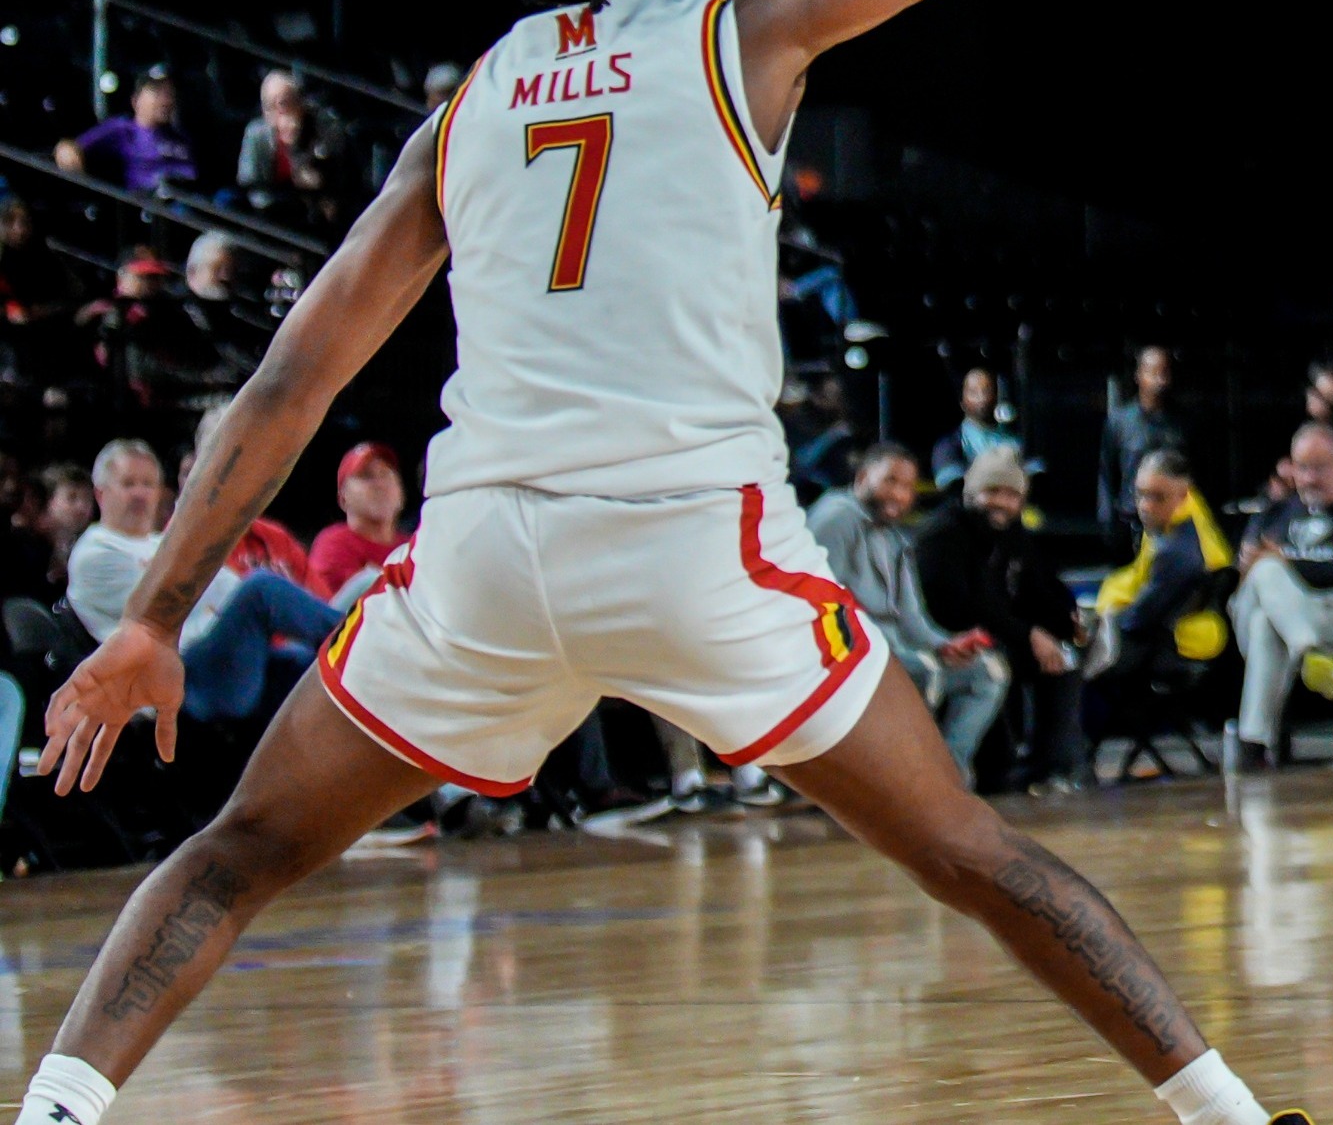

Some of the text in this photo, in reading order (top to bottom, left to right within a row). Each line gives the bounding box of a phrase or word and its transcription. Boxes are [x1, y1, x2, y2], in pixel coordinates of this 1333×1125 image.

[555, 6, 597, 55] M
[508, 52, 632, 110] MILLS
[525, 112, 614, 293] 7
